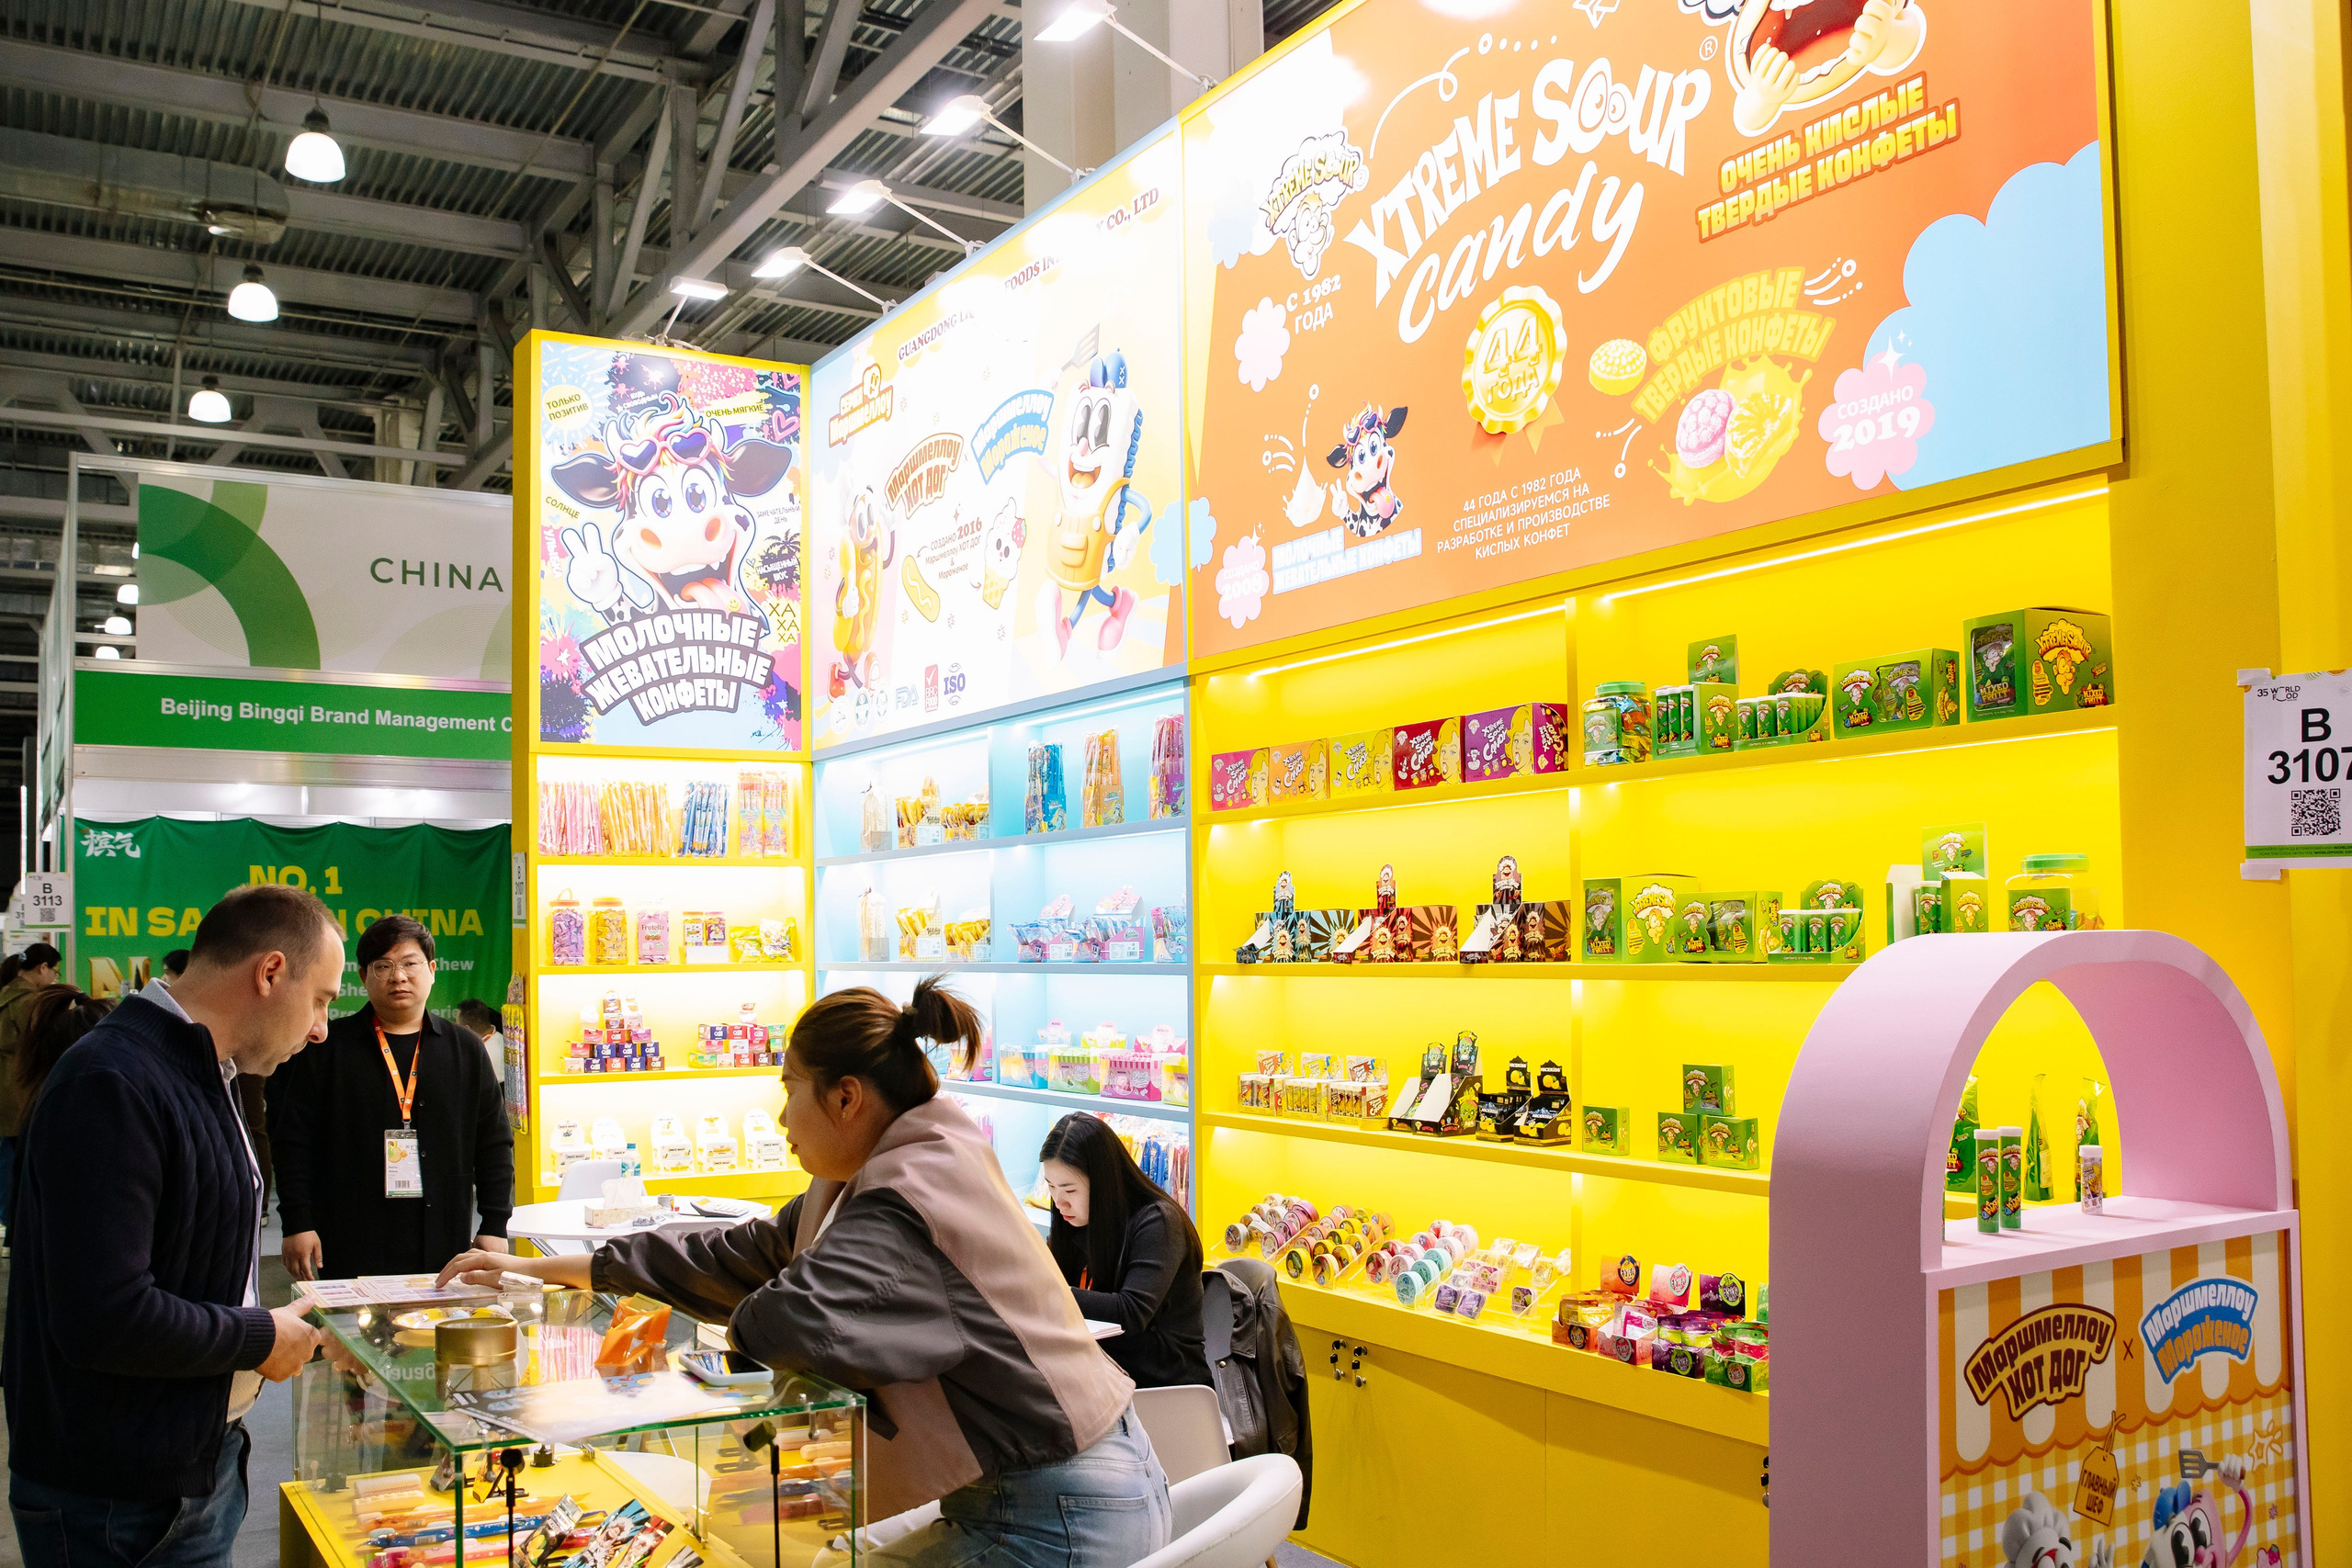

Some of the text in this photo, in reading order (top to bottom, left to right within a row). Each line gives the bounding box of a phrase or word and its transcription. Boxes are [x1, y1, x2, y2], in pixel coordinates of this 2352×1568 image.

[1721, 76, 1924, 194] ОЧЕНЬ КИСЛЫЕ
[1698, 106, 1958, 240] ТВЕРДЫЕ КОНФЕТЫ
[1343, 116, 1521, 310] XTREME
[898, 313, 957, 361] GUANGDONG
[1133, 186, 1159, 216] LTD
[1302, 275, 1342, 308] 1982
[1294, 301, 1334, 335] ГОДА
[1647, 270, 1804, 362] ФРУКТОВЫЕ
[1483, 317, 1544, 366] 44
[1636, 313, 1835, 419] ТВЕРДЫЕ КОНФЕТЫ
[1486, 367, 1540, 401] ГОДА
[546, 394, 582, 410] ТОЛЬКО
[548, 402, 589, 421] ПОЗИТИВ
[706, 402, 764, 418] ОЧЕНЬ МЯГКИЕ
[1838, 385, 1914, 419] СОЗДАНО
[1832, 405, 1921, 452] 2019
[545, 496, 580, 519] СОЛНЦЕ
[1463, 499, 1476, 513] 44
[1478, 490, 1507, 511] ГОДА
[1521, 477, 1546, 496] 1982
[1550, 468, 1581, 488] ГОДА
[1437, 494, 1611, 553] РАЗРАБОТКЕ И ПРОИЗВОДСТВЕ
[1453, 483, 1589, 533] СПЕЦИАЛИЗИРУЕМСЯ НА
[957, 517, 983, 540] 2016
[1476, 523, 1570, 560] КИСЛЫХ КОНФЕТ
[369, 558, 504, 592] CHINA
[583, 613, 759, 671] МОЛОЧНЫЕ
[2035, 629, 2066, 651] XTREME
[585, 646, 773, 711] ЖЕВАТЕЛЬНЫЕ
[944, 673, 966, 694] ISO
[1980, 682, 2009, 695] MIXED
[2084, 689, 2104, 697] MIXED
[2257, 688, 2268, 697] 35
[632, 677, 737, 723] КОНФЕТЫ
[896, 684, 919, 709] FDA
[160, 697, 495, 733] Beijing Bingqi Brand Management
[1482, 717, 1504, 737] XTREME
[2301, 708, 2332, 743] B
[1409, 729, 1431, 749] XTREME
[1416, 736, 1432, 752] SOUR
[1483, 729, 1508, 761] CANDY
[1489, 724, 1505, 741] SOUR
[1410, 740, 1434, 771] CANDY
[33, 896, 62, 906] 3113
[42, 884, 52, 894] B
[85, 907, 138, 936] IN
[2144, 1285, 2255, 1347] Маршмеллоу
[1972, 1314, 2111, 1393] Маршмеллоу
[2156, 1314, 2251, 1377] Мороженое
[2009, 1348, 2086, 1410] ХОТ ДОГ
[2080, 1469, 2117, 1500] ГЛАВНЫЙ
[2086, 1497, 2104, 1517] ШЕФ
